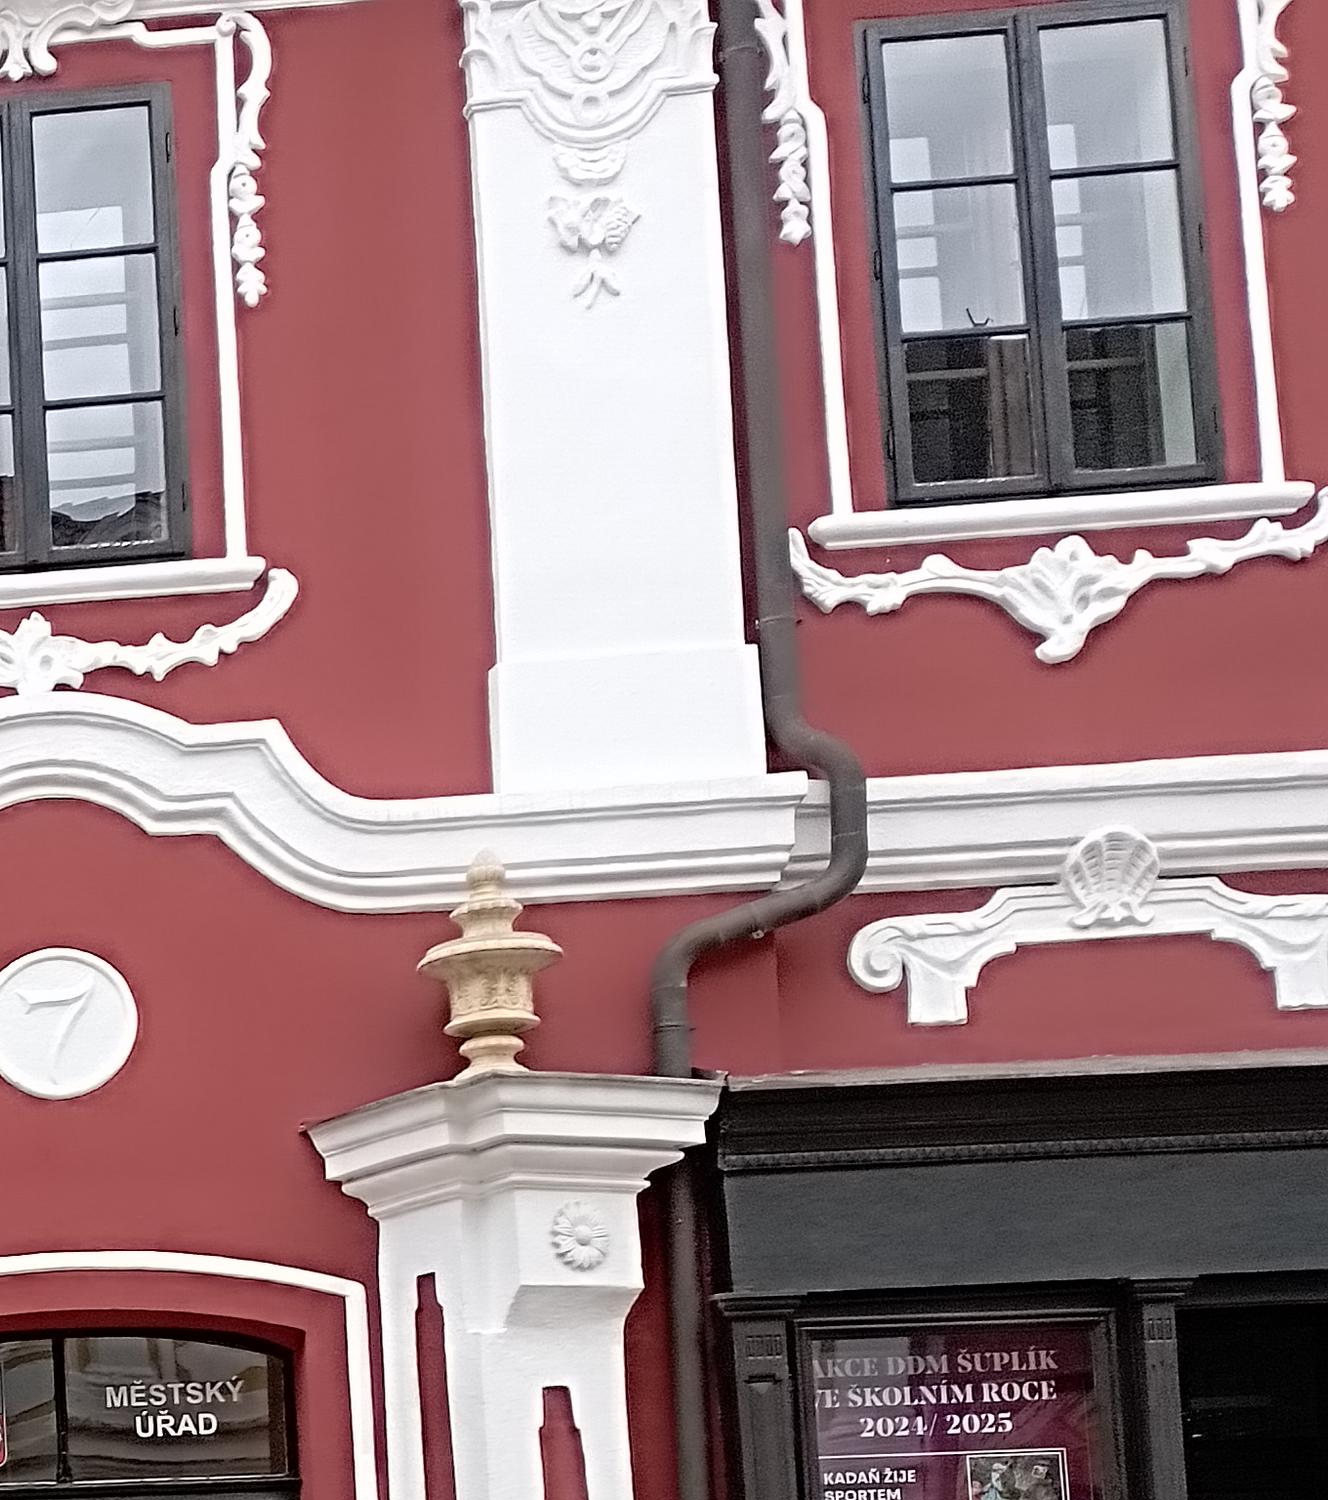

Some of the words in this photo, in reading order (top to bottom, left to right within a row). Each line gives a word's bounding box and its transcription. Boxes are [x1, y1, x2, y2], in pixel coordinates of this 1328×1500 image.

[15, 969, 96, 1087] 7
[813, 1357, 878, 1378] AKCE
[887, 1354, 949, 1376] DDM
[957, 1346, 1059, 1373] ŠUPLÍK
[105, 1375, 244, 1408] MĚSTSKÝ
[848, 1380, 974, 1407] ŠKOLNÍM
[982, 1380, 1057, 1403] ROCE
[135, 1409, 218, 1438] ÚŘAD
[946, 1411, 1013, 1435] 2025
[823, 1468, 880, 1485] KADAŇ
[884, 1467, 916, 1483] ŽIJE
